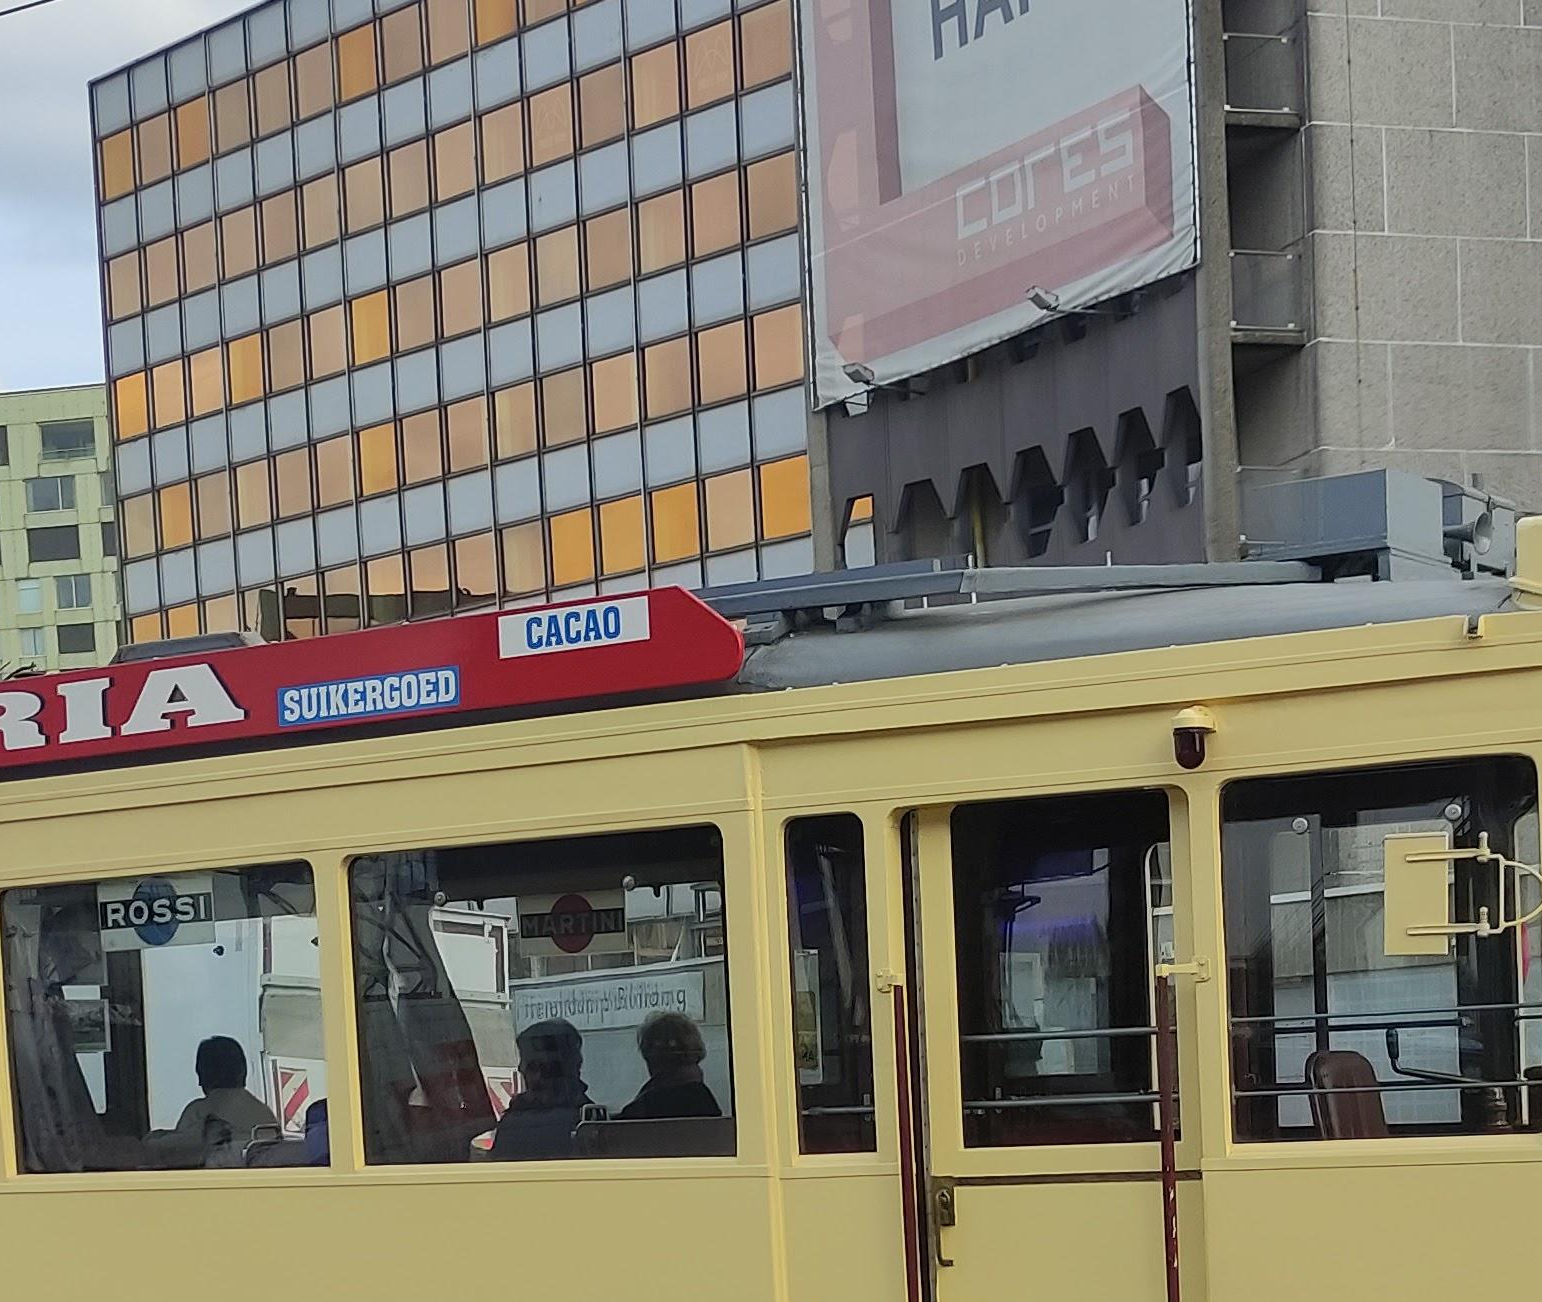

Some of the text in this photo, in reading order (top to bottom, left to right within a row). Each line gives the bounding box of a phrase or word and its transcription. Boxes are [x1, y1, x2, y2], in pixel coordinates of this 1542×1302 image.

[959, 175, 1135, 266] DEVELOPMENT
[525, 605, 621, 650] CACAO
[283, 670, 457, 722] SUIKERGOED
[106, 896, 206, 928] ROSSI
[522, 909, 623, 936] MARTINI
